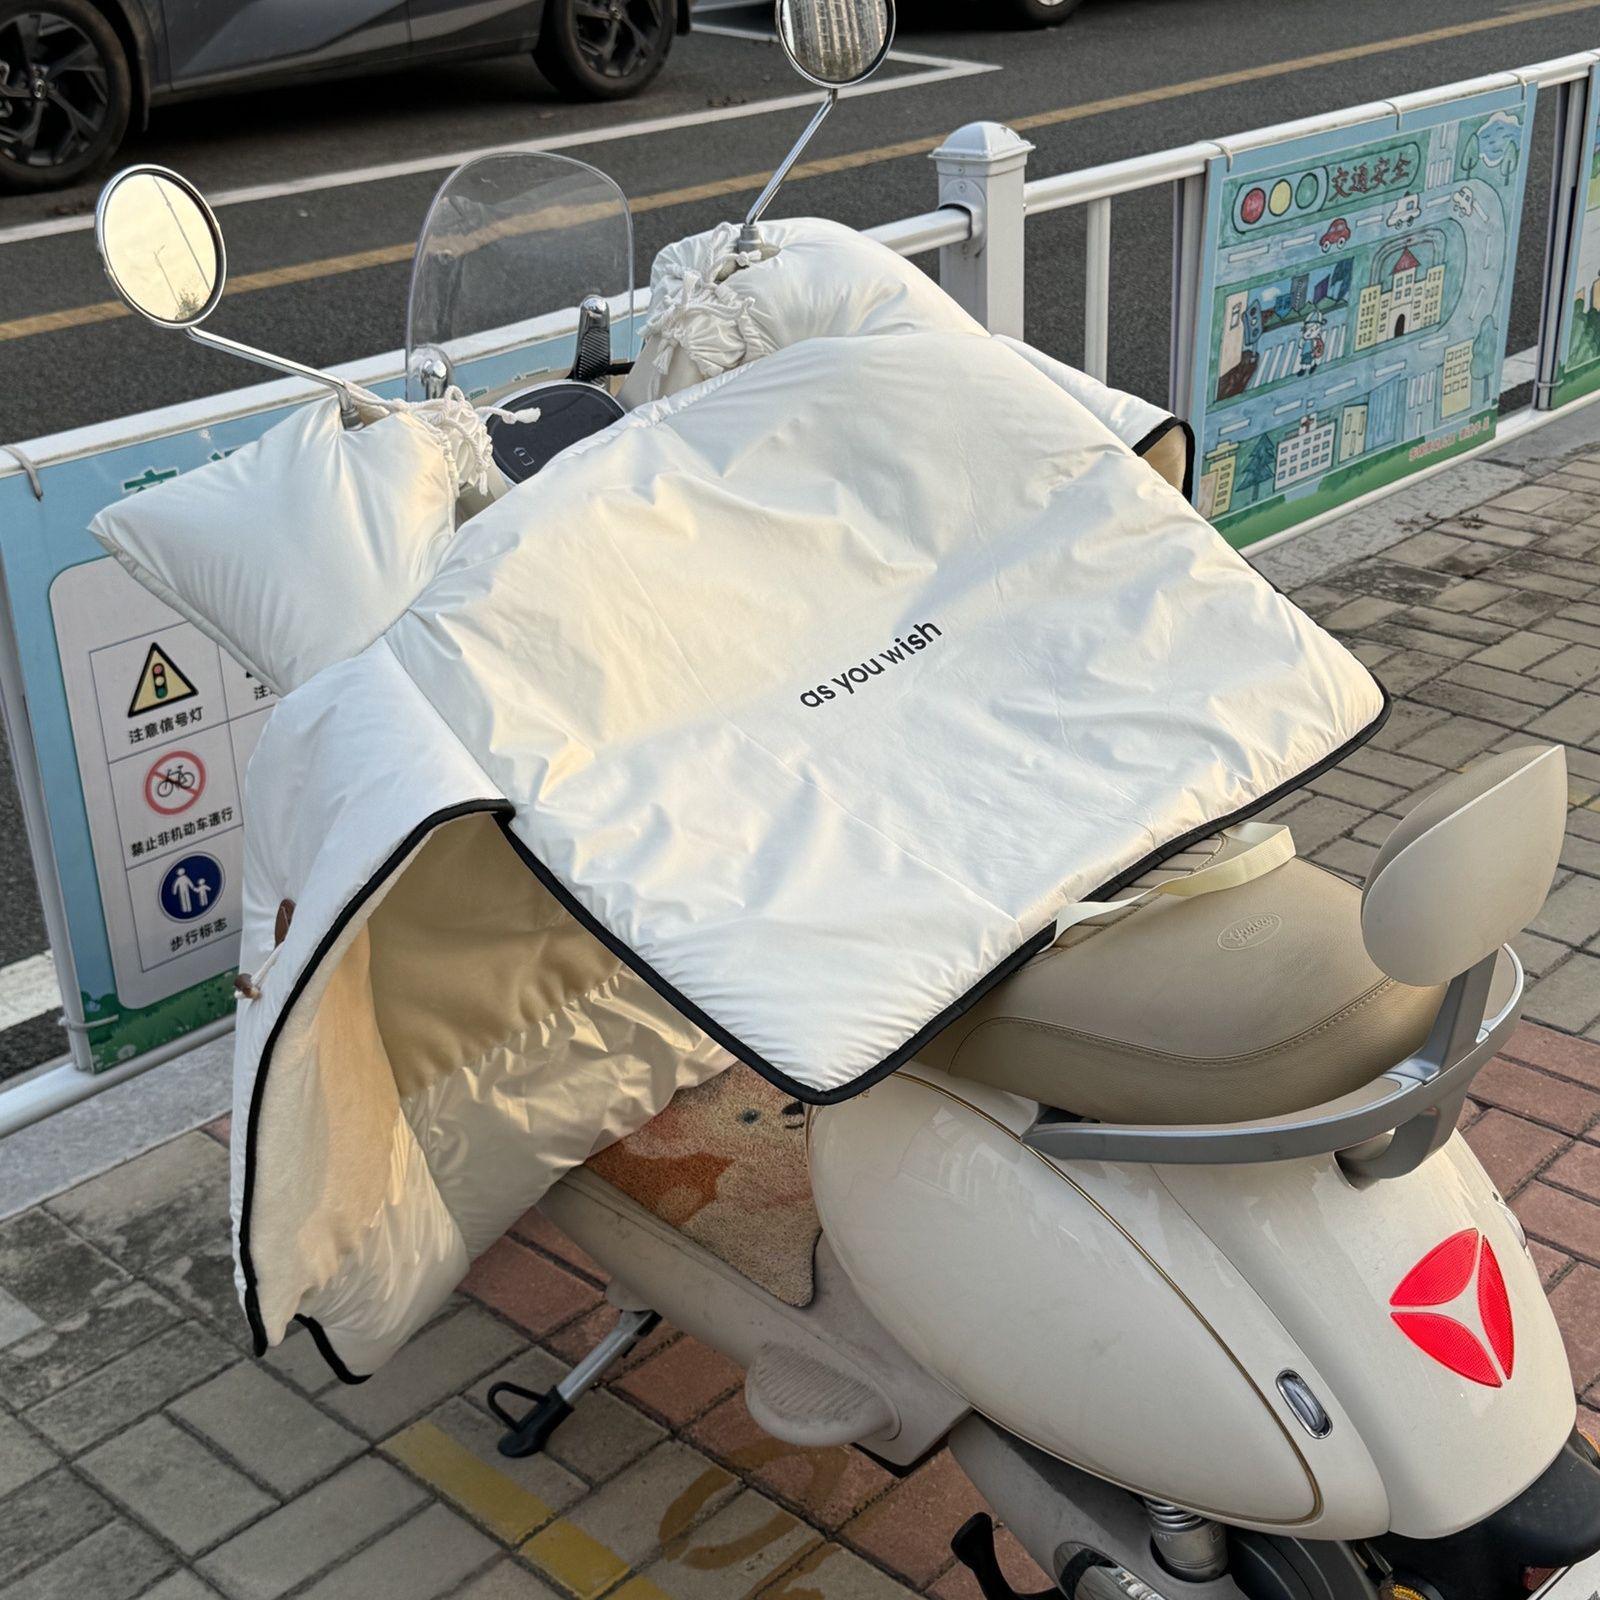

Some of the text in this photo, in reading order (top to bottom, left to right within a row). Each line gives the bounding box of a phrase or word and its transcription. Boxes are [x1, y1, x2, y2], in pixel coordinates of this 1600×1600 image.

[800, 622, 943, 708] as you wish
[254, 684, 274, 701] 注
[128, 706, 204, 745] 注意信号灯
[131, 807, 234, 857] 禁止非机动车通行
[170, 917, 228, 952] 步行标志
